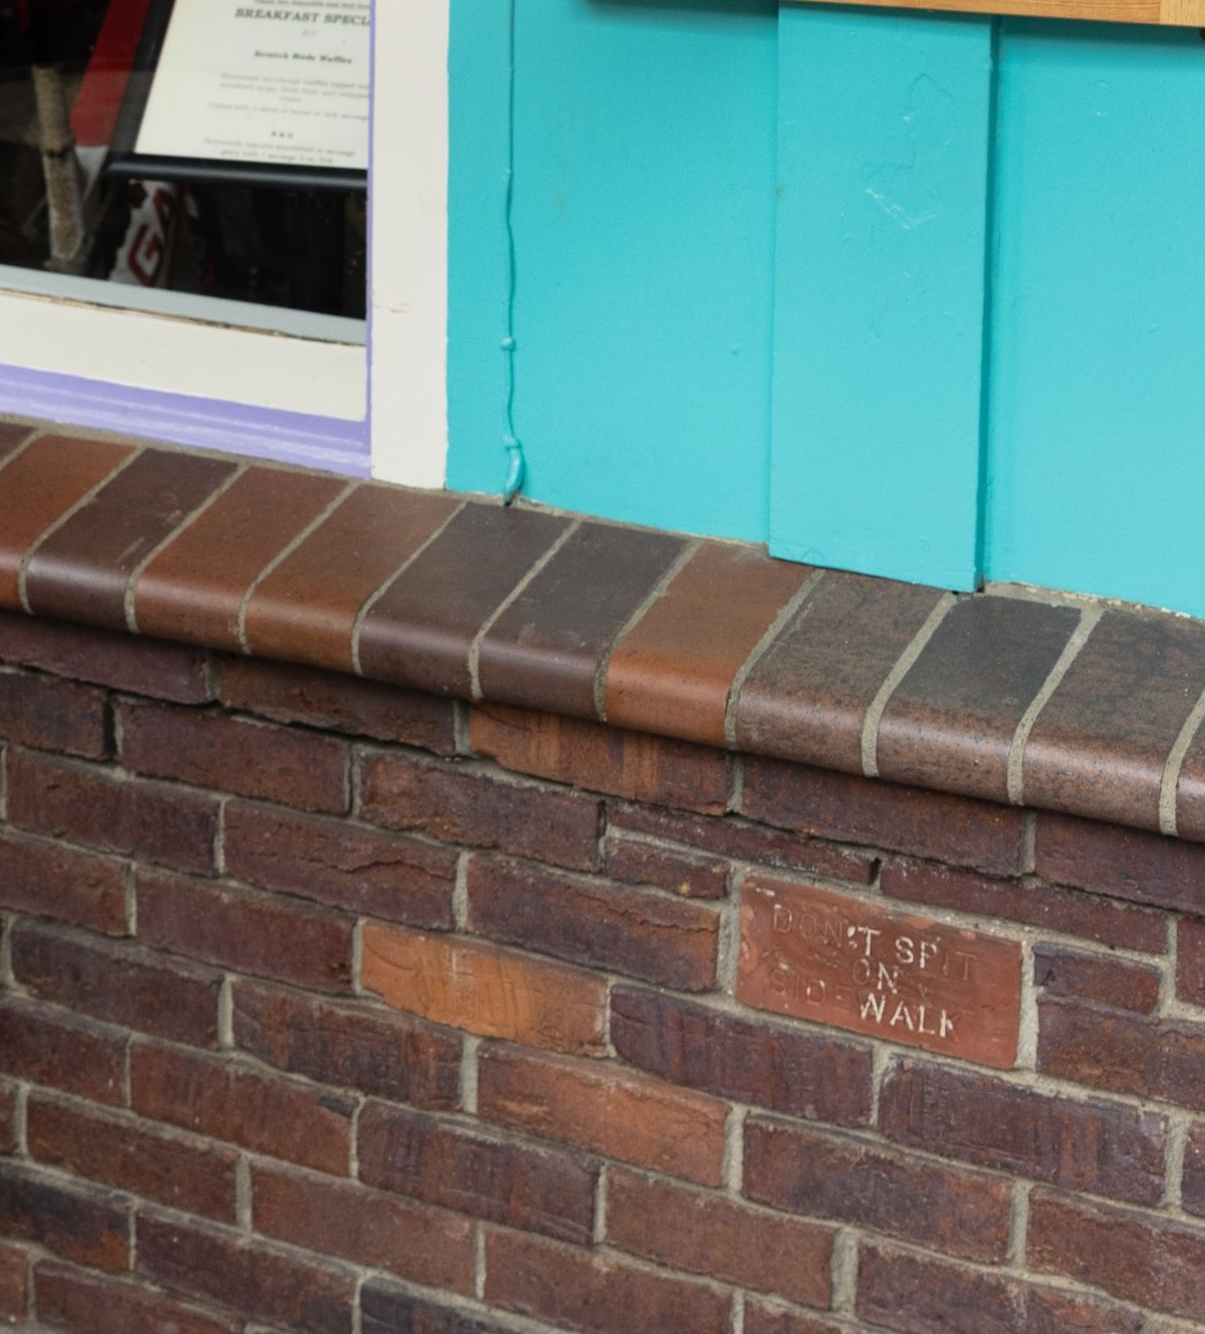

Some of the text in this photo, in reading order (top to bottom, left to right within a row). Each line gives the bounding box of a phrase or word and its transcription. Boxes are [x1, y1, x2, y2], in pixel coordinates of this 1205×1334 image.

[235, 7, 321, 24] BREAKFAST
[772, 904, 977, 982] DON'T SPIT
[852, 958, 898, 995] ON
